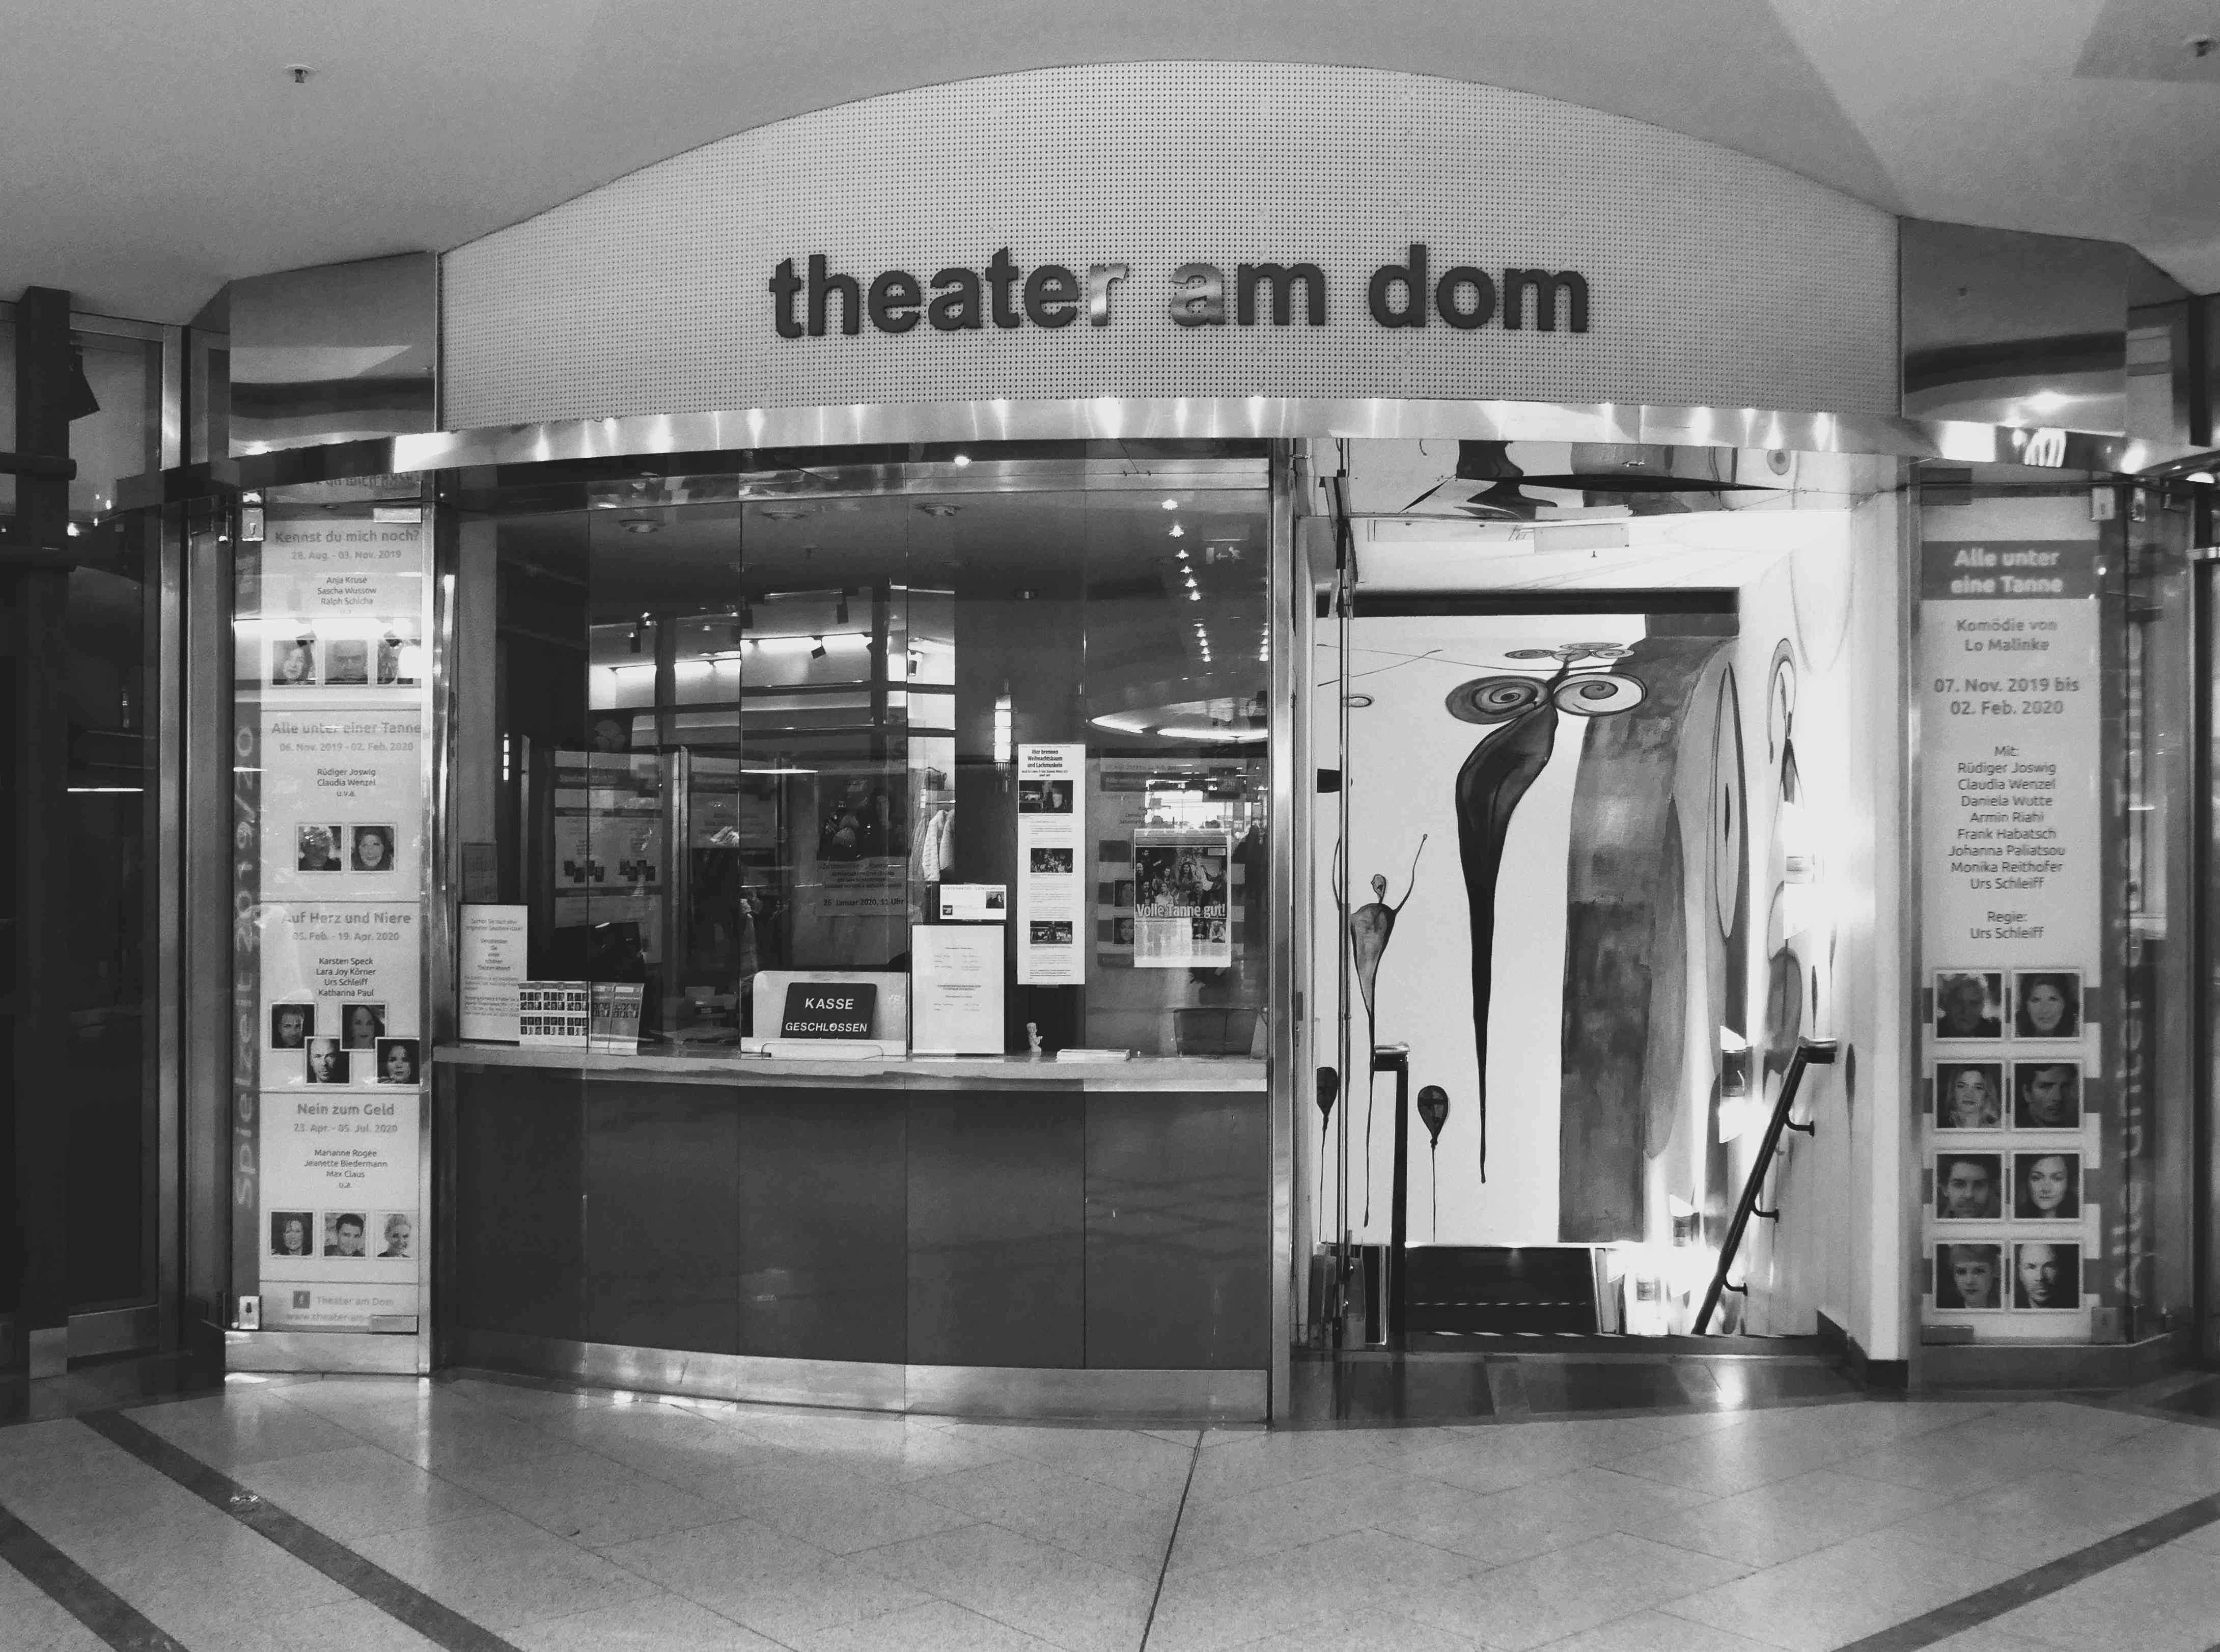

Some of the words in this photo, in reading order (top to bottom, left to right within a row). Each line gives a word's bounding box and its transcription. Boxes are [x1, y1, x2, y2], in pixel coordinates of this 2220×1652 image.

[768, 246, 1128, 339] theater
[1168, 258, 1326, 327] am
[1368, 243, 1591, 334] dom
[275, 531, 322, 542] Kennst
[326, 531, 342, 542] du
[346, 530, 377, 542] mich
[382, 530, 421, 541] noch?
[378, 550, 402, 559] 2019
[1954, 547, 1996, 567] Alle
[2002, 549, 2061, 567] unter
[326, 576, 344, 585] Anja
[1950, 574, 1995, 594] eine
[2001, 575, 2064, 593] Tanne
[321, 598, 343, 606] Ralph
[1956, 618, 2025, 632] Komödie
[2029, 622, 2058, 631] von
[1964, 639, 1983, 652] Lo
[1987, 638, 2049, 651] Malinke
[1934, 678, 1960, 693] 07.
[1965, 678, 2002, 693] Nov.
[2008, 678, 2050, 693] 2019
[2054, 677, 2080, 692] bis
[1950, 701, 1976, 715] 02.
[1981, 700, 2017, 714] Feb.
[2022, 700, 2064, 714] 2020
[272, 723, 298, 734] Alle
[303, 723, 338, 734] unter
[343, 722, 377, 733] einer
[381, 722, 421, 734] Tanne
[320, 743, 343, 751] 2019
[368, 742, 388, 751] Feb.
[390, 742, 413, 751] 2020
[317, 768, 347, 777] Rüdiger
[349, 768, 376, 777] Joswig
[1957, 762, 2007, 776] Rüdiger
[2011, 762, 2057, 776] Joswig
[1958, 779, 2006, 790] Claudia
[2008, 778, 2056, 790] Wenzel
[1961, 795, 2009, 807] Daniela
[2013, 795, 2053, 807] Wutte
[1969, 812, 2009, 823] Armin
[1957, 829, 1993, 840] Frank
[1996, 828, 2057, 840] Habatsch
[1948, 844, 2003, 857] Johanna
[1951, 862, 1999, 873] Monika
[2002, 861, 2063, 873] Reithofer
[1970, 878, 1992, 889] Urs
[1136, 903, 1164, 918] Volle
[1165, 903, 1202, 918] Tanne
[1203, 903, 1226, 919] gut!
[281, 912, 306, 924] Auf
[310, 912, 341, 924] Herz
[345, 912, 370, 924] und
[374, 912, 411, 924] Niere
[1987, 911, 2027, 925] Regie:
[338, 932, 351, 941] 19.
[354, 932, 373, 943] Apr.
[376, 932, 400, 941] 2020
[1970, 928, 1992, 939] Urs
[1995, 926, 2045, 940] Schleiff
[350, 958, 374, 967] Speck
[335, 969, 348, 977] Joy
[350, 968, 376, 976] Körner
[804, 998, 854, 1010] KASSE
[785, 1022, 868, 1032] GESCHLOSSEN
[234, 967, 257, 1211] Spielzeit
[297, 1104, 328, 1115] Nein
[332, 1106, 359, 1115] zum
[364, 1104, 395, 1116] Geld
[375, 1124, 398, 1133] 2020
[340, 1160, 387, 1168] Biedermann
[344, 1170, 365, 1178] Claus
[316, 1295, 353, 1306] Theater
[356, 1298, 370, 1306] am
[372, 1297, 394, 1306] Dom
